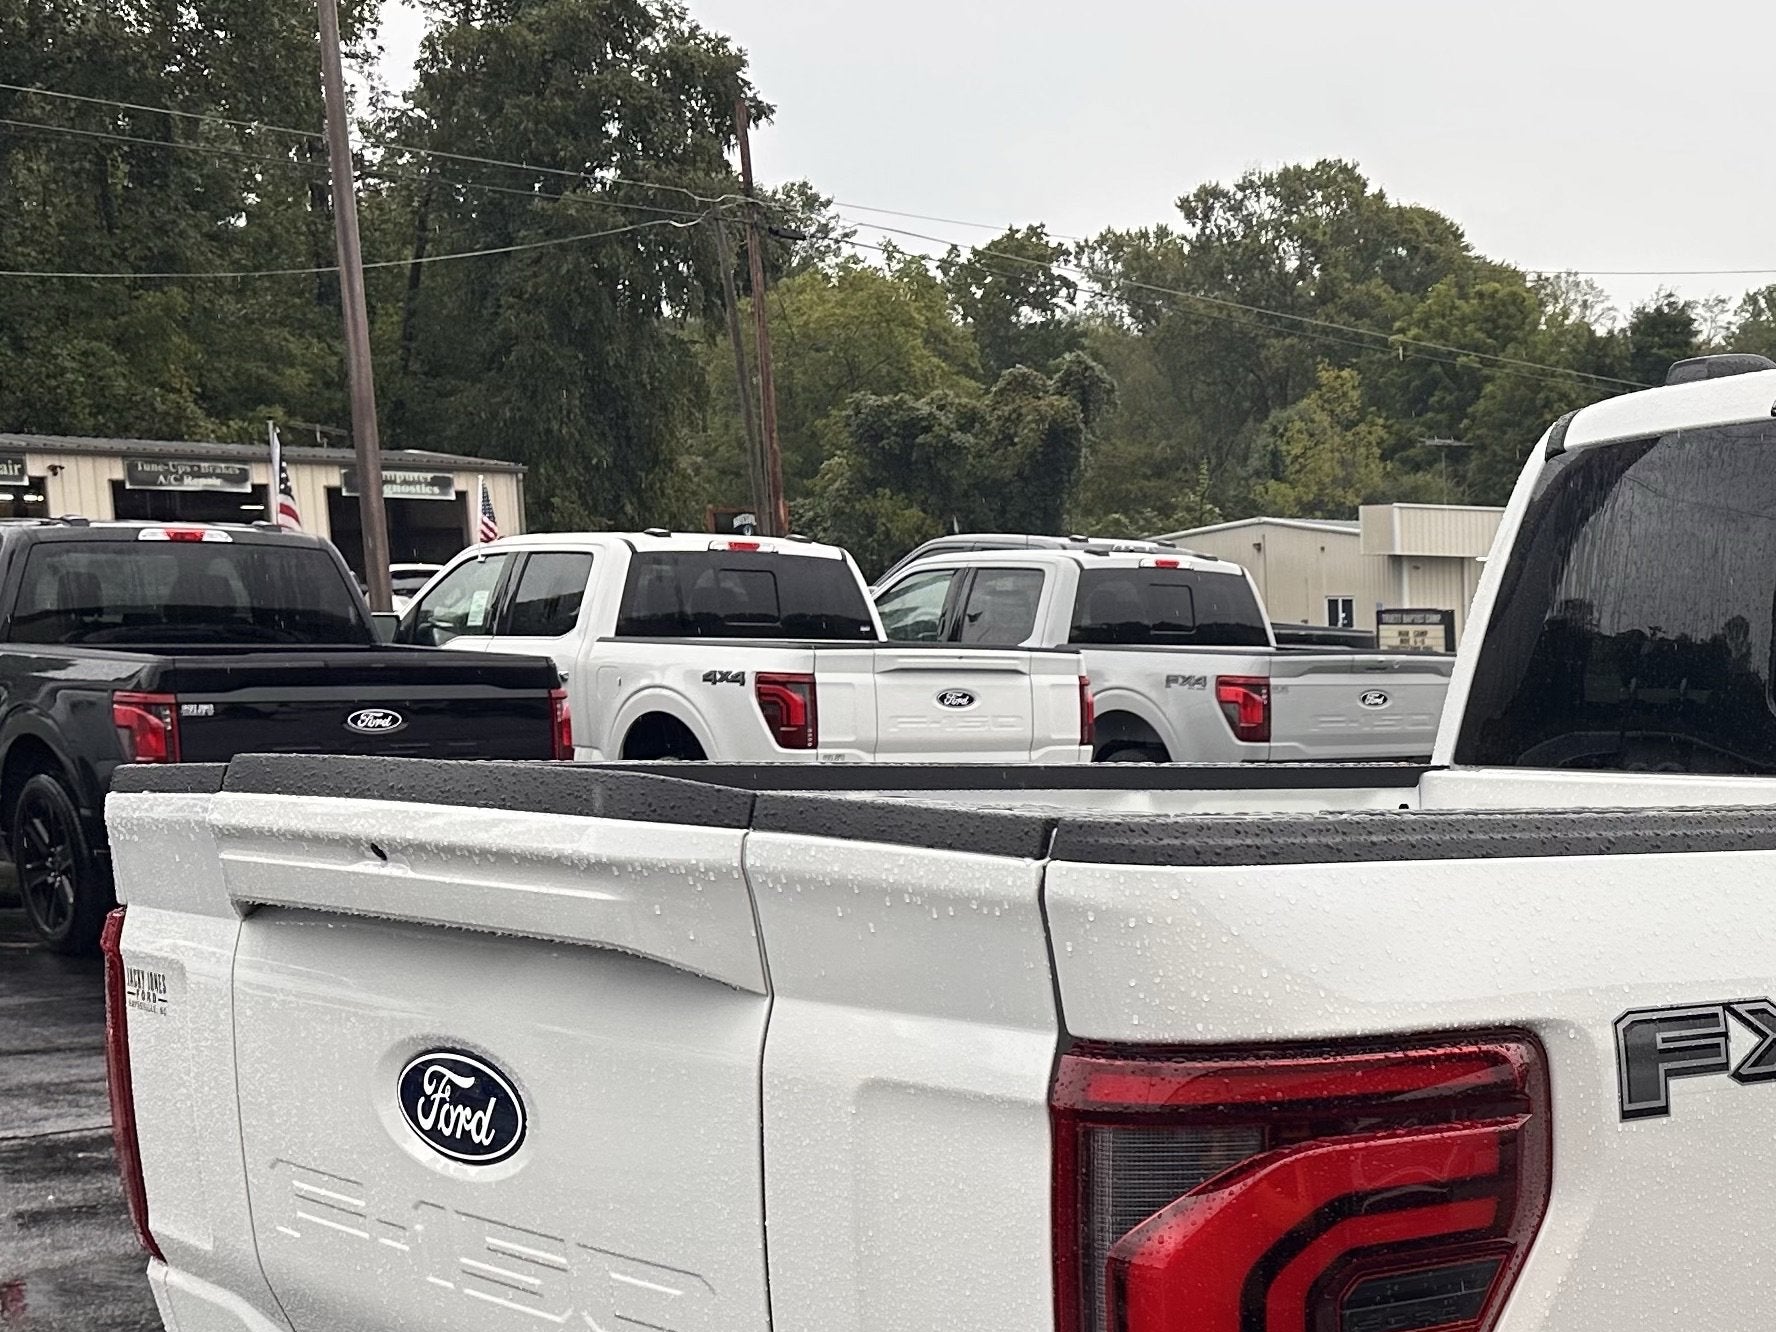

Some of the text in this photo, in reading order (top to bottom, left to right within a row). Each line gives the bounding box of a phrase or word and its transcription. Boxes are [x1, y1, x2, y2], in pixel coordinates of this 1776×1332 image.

[157, 475, 222, 487] A/C Repair
[382, 472, 432, 483] mputer
[383, 484, 440, 495] gnostics
[1165, 675, 1208, 689] FX4
[943, 688, 970, 706] Ford
[1364, 693, 1385, 705] Ford
[357, 712, 392, 728] Ford
[147, 971, 167, 994] JONES
[136, 989, 157, 1003] FORD
[416, 1064, 497, 1146] Ford
